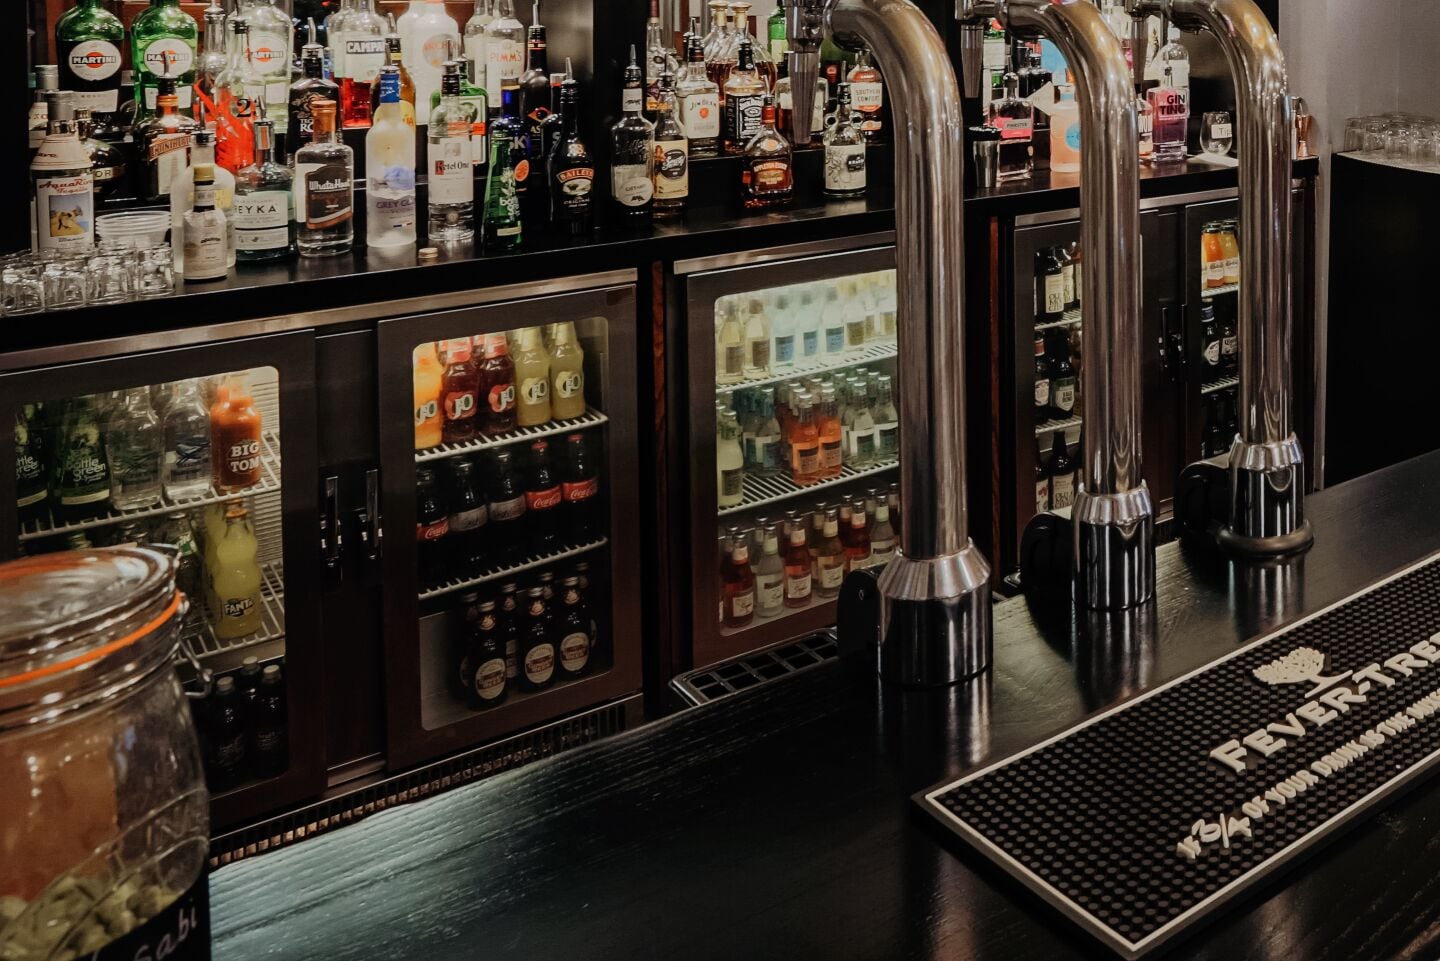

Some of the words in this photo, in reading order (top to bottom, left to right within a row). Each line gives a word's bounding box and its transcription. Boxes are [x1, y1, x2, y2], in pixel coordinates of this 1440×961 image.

[71, 56, 117, 65] MARTINI
[1166, 95, 1186, 105] GIN
[1160, 105, 1186, 115] TING
[231, 441, 260, 457] BIG
[230, 458, 260, 473] TOM
[1177, 835, 1201, 860] IF
[1191, 812, 1253, 849] 3/4
[1242, 795, 1270, 820] OF
[1265, 769, 1319, 805] YOUR
[1311, 739, 1369, 778] DRINK
[1359, 729, 1386, 750] IS
[1376, 711, 1416, 737] THE
